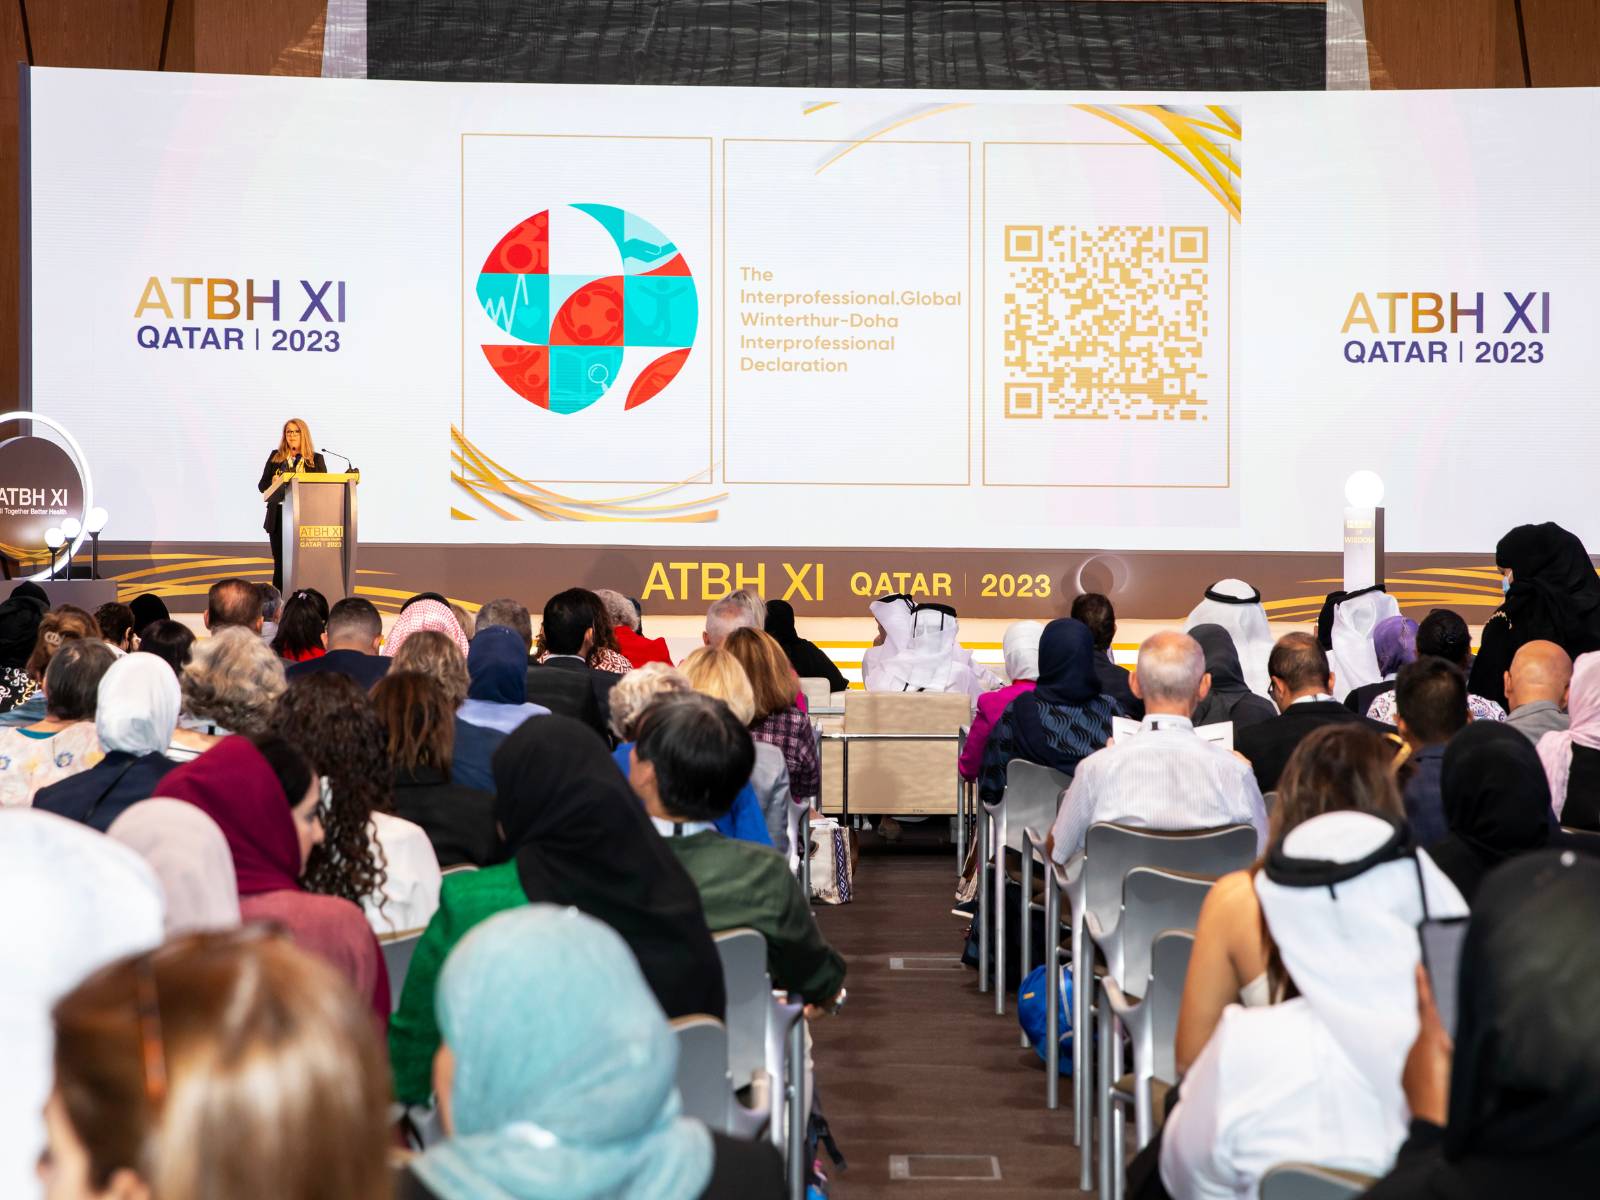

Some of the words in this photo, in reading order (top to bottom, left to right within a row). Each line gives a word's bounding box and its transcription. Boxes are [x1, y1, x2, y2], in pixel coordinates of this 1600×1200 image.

[740, 266, 774, 282] The
[134, 276, 280, 321] ATBH
[299, 280, 346, 323] XI
[740, 288, 962, 307] Interprofessional.Global
[740, 311, 899, 328] Winterthur-Doha
[1340, 292, 1484, 334] ATBH
[1502, 292, 1550, 334] XI
[137, 325, 244, 350] QATAR
[272, 329, 341, 352] 2023
[740, 334, 896, 352] Interprofessional
[1344, 340, 1448, 364] QATAR
[1475, 341, 1544, 364] 2023
[740, 356, 848, 373] Declaration
[0, 487, 45, 506] ATBH
[50, 488, 68, 506] XI
[4, 507, 29, 516] Together
[641, 562, 765, 600] ATBH
[782, 563, 824, 601] XI
[850, 572, 952, 597] QATAR
[981, 573, 1052, 598] 2023
